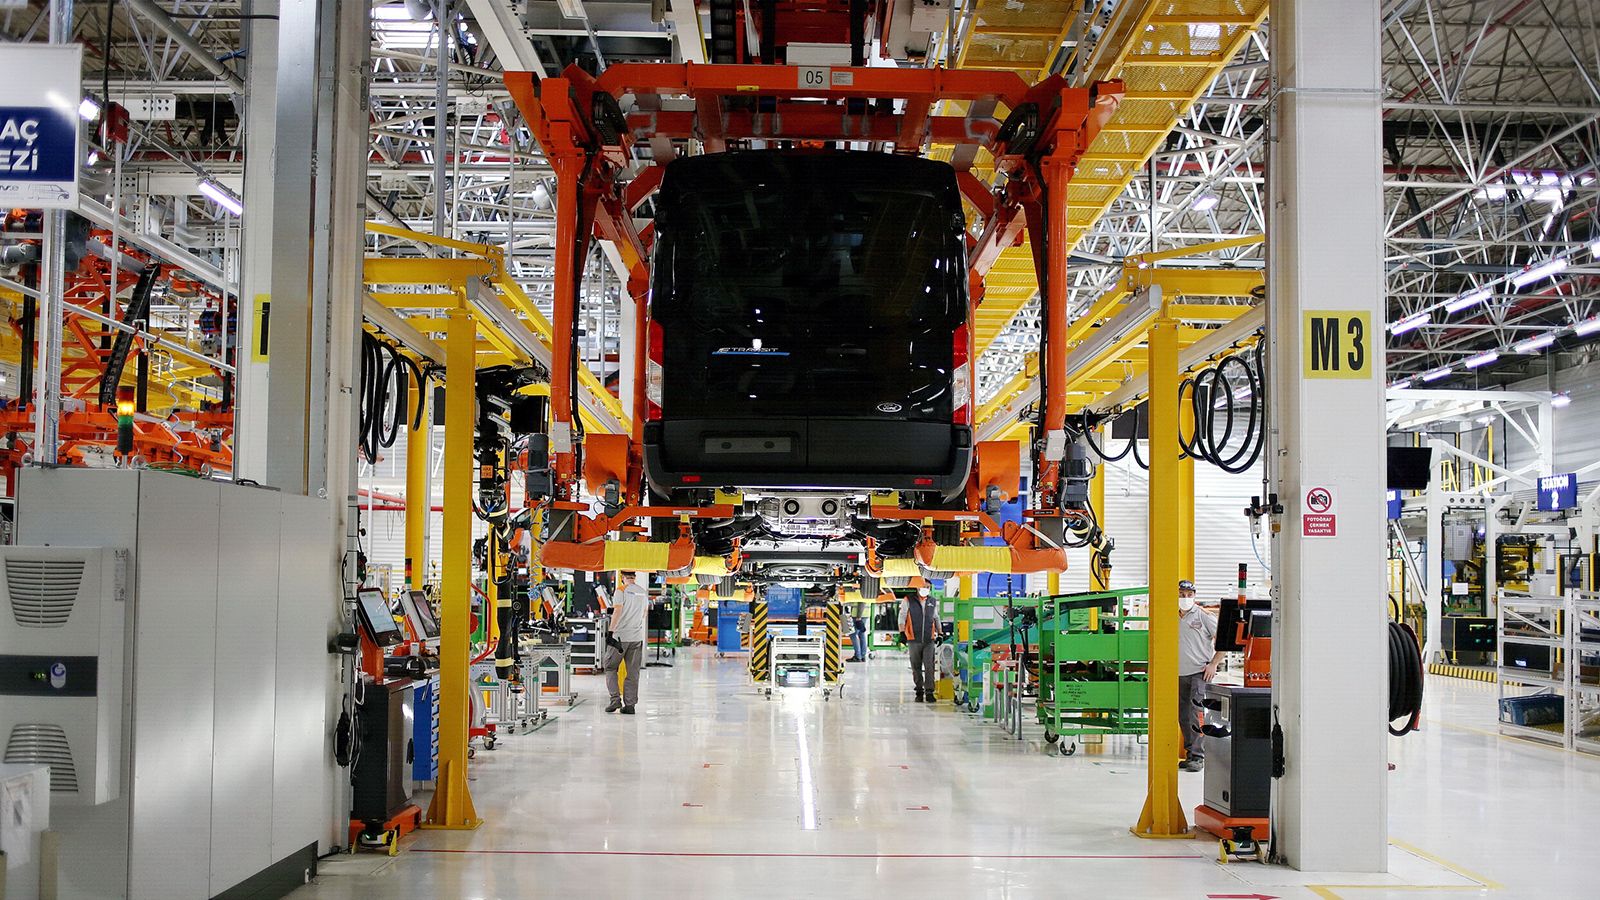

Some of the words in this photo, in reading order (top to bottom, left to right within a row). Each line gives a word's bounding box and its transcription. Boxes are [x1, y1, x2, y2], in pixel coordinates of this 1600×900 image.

[805, 70, 824, 84] 05
[1541, 475, 1569, 491] STATION
[1551, 489, 1560, 508] 2
